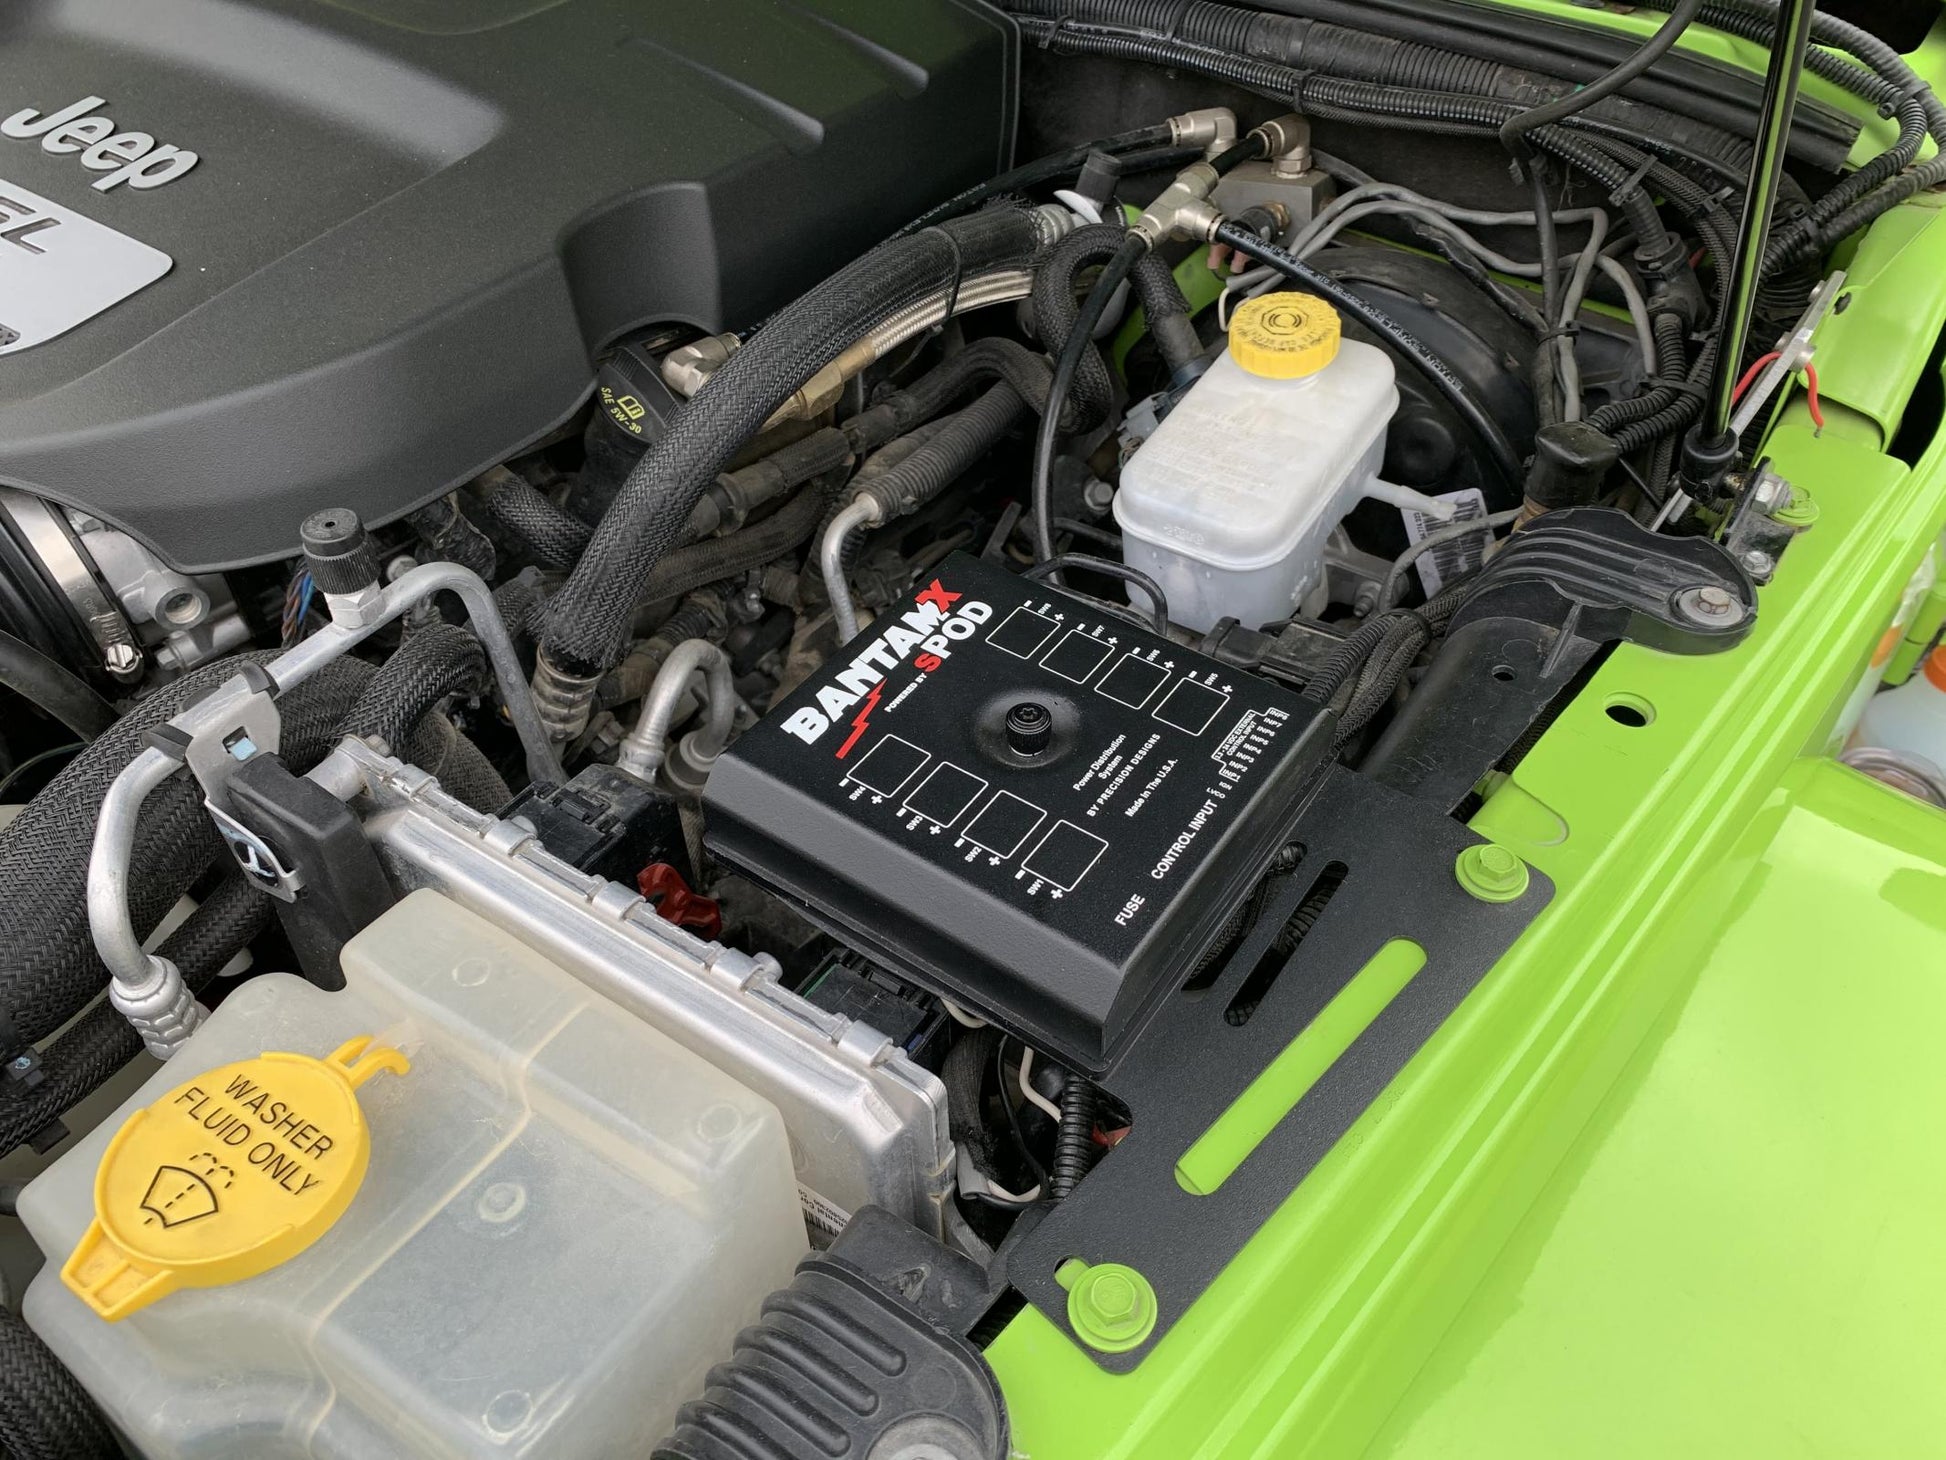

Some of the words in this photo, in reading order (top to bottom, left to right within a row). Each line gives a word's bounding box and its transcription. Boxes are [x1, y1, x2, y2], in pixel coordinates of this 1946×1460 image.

[0, 95, 199, 193] Jeep
[601, 387, 615, 405] SAE
[610, 407, 642, 434] 5W-30
[884, 681, 918, 713] POWERED
[915, 672, 927, 684] BY
[1263, 717, 1283, 728] INP7
[1269, 709, 1289, 721] INP8
[1226, 735, 1247, 756] CONTROL
[1243, 720, 1257, 735] INPUT
[1256, 725, 1276, 737] INP6
[1242, 742, 1262, 755] INP4
[1249, 734, 1270, 746] INP5
[1072, 769, 1095, 791] Power
[1090, 734, 1127, 771] Distribution
[1235, 751, 1255, 763] INP3
[1098, 754, 1123, 779] System
[1156, 758, 1179, 778] U.S.A.
[1222, 768, 1241, 780] INP1
[1228, 760, 1249, 772] INP2
[1086, 803, 1100, 817] BY
[1096, 764, 1134, 805] PRECISION
[1130, 733, 1161, 765] DESIGNS
[848, 785, 867, 801] SW4
[1145, 778, 1162, 791] The
[1206, 787, 1226, 799] LVCO
[1218, 781, 1233, 790] IGN
[1139, 790, 1152, 799] In
[1124, 797, 1145, 817] Made
[905, 815, 924, 831] SW3
[1150, 831, 1197, 880] CONTROL
[1188, 798, 1218, 831] INPUT
[964, 846, 983, 863] SW2
[1026, 878, 1045, 896] SW1
[1114, 893, 1146, 927] FUSE
[224, 1073, 334, 1161] WASHER
[173, 1086, 252, 1147] FLUID
[247, 1141, 322, 1197] ONLY
